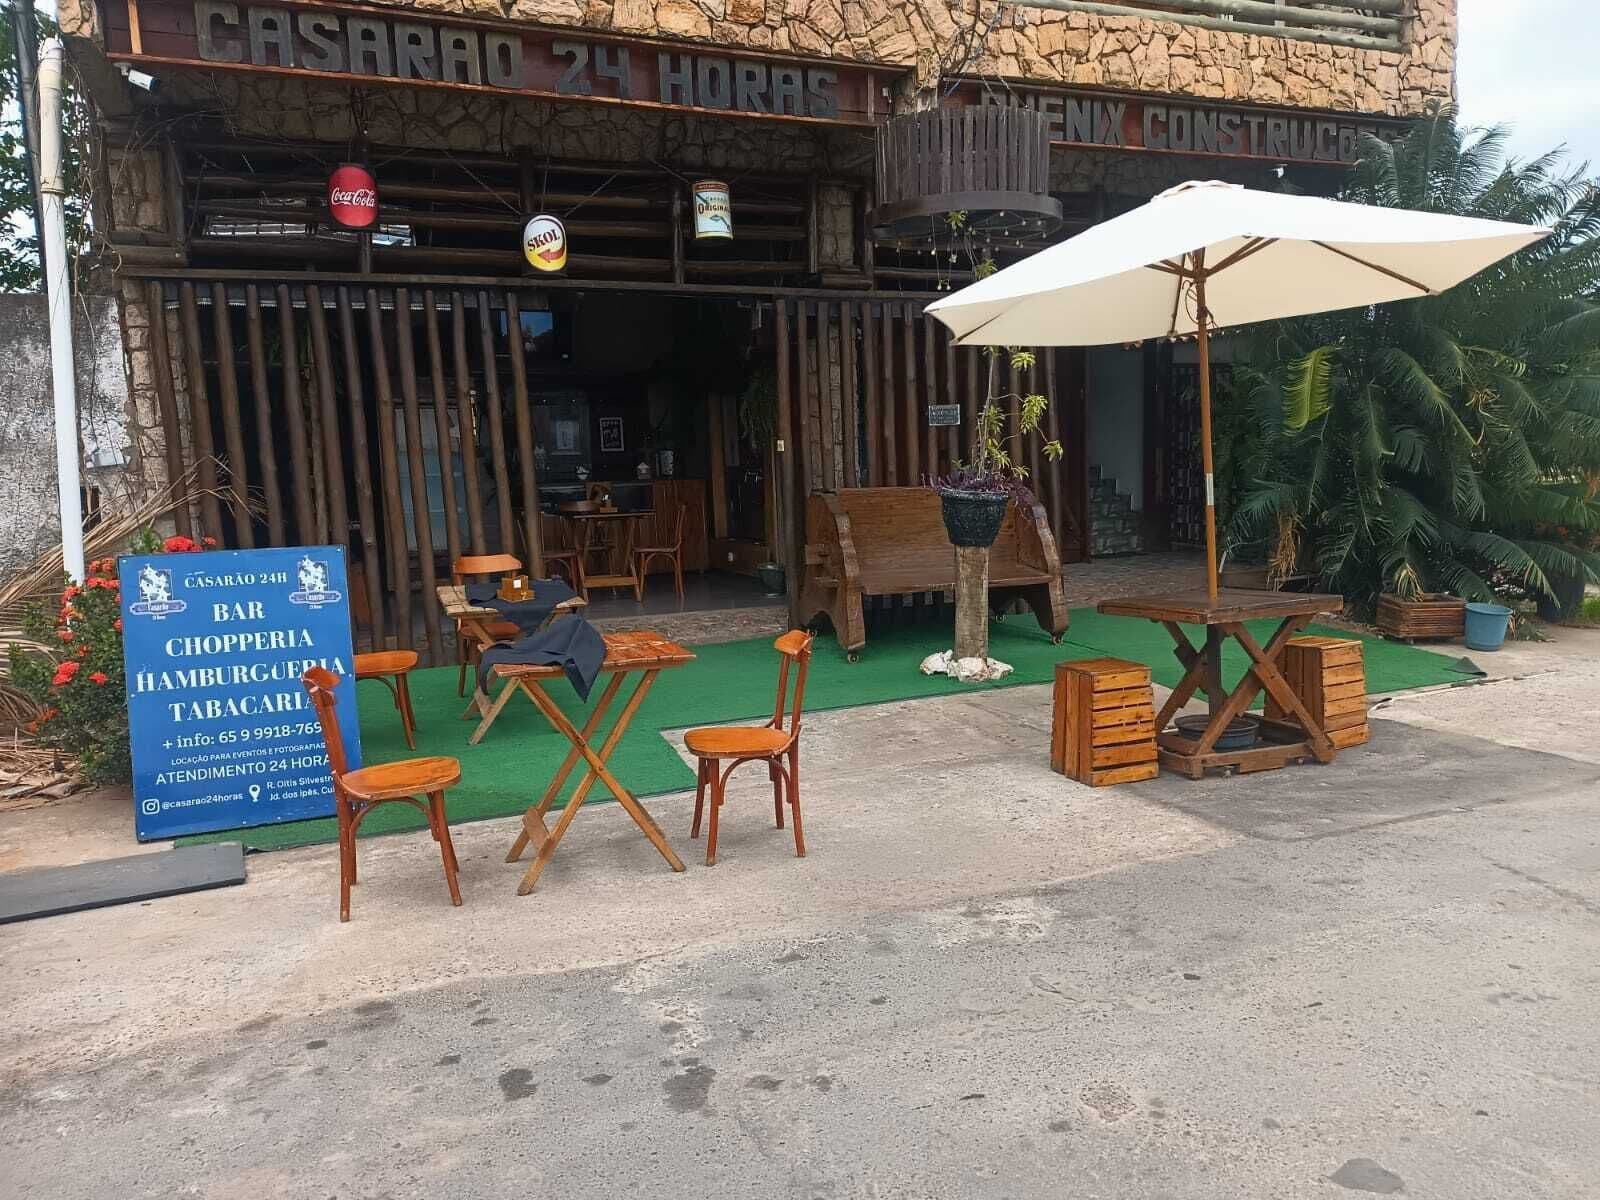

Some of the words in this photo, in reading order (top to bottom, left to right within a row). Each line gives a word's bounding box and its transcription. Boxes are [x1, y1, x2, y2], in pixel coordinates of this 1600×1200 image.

[552, 39, 632, 97] 24
[657, 50, 838, 118] HORAS
[331, 187, 375, 208] Coca-Cola
[527, 229, 560, 252] SKOL
[184, 573, 256, 589] CASARÃO
[260, 571, 287, 585] 24H
[212, 601, 266, 623] BAR
[165, 627, 315, 657] CHOPPERIA
[176, 732, 215, 749] info:
[218, 730, 237, 744] 65
[240, 728, 250, 742] 9
[253, 721, 323, 740] 9918-769
[171, 754, 209, 766] LOCAÇÃO
[210, 752, 231, 761] PARA
[232, 747, 267, 760] EVENTOS
[268, 747, 274, 755] E
[156, 761, 266, 786] ATENDIMENTO
[269, 758, 288, 773] 24
[291, 753, 330, 769] HORA
[282, 790, 298, 800] dos
